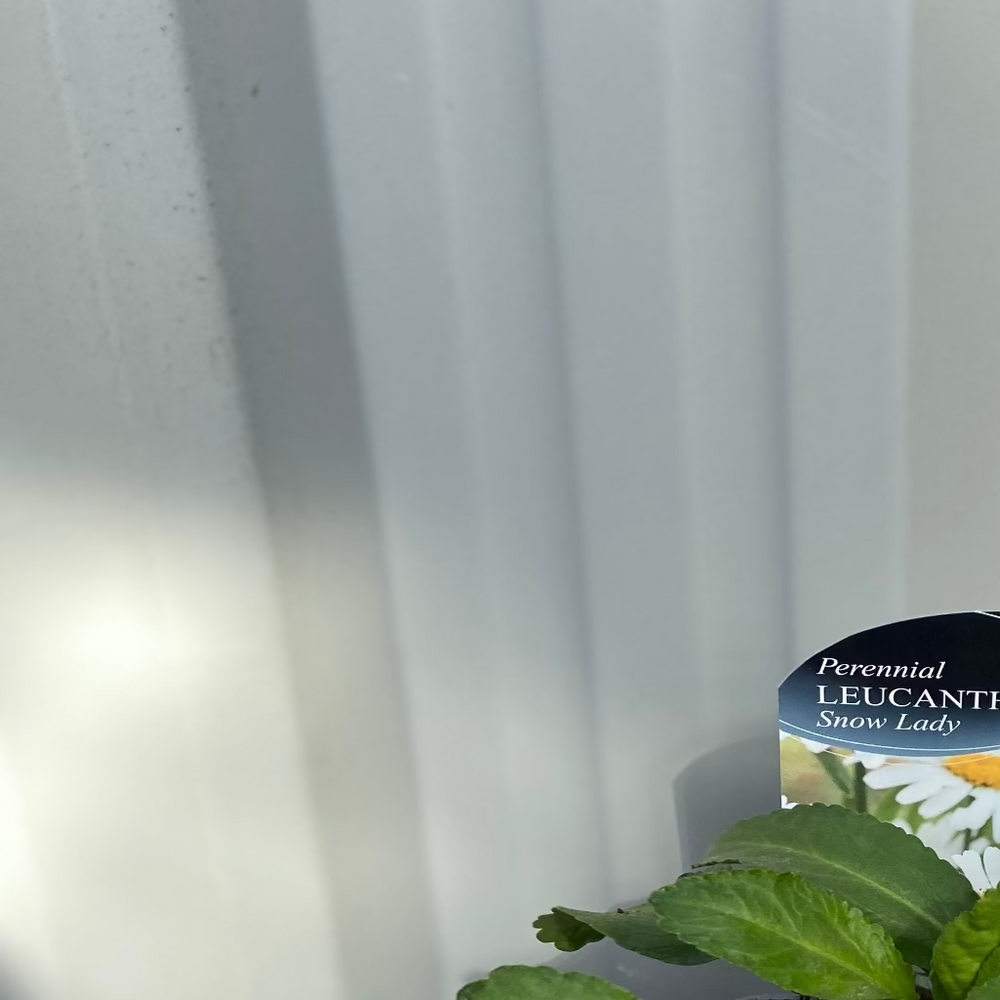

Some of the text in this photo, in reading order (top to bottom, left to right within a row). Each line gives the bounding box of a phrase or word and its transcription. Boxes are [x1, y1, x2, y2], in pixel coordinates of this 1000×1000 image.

[816, 657, 947, 679] Perennial
[816, 709, 961, 736] Snow Lady
